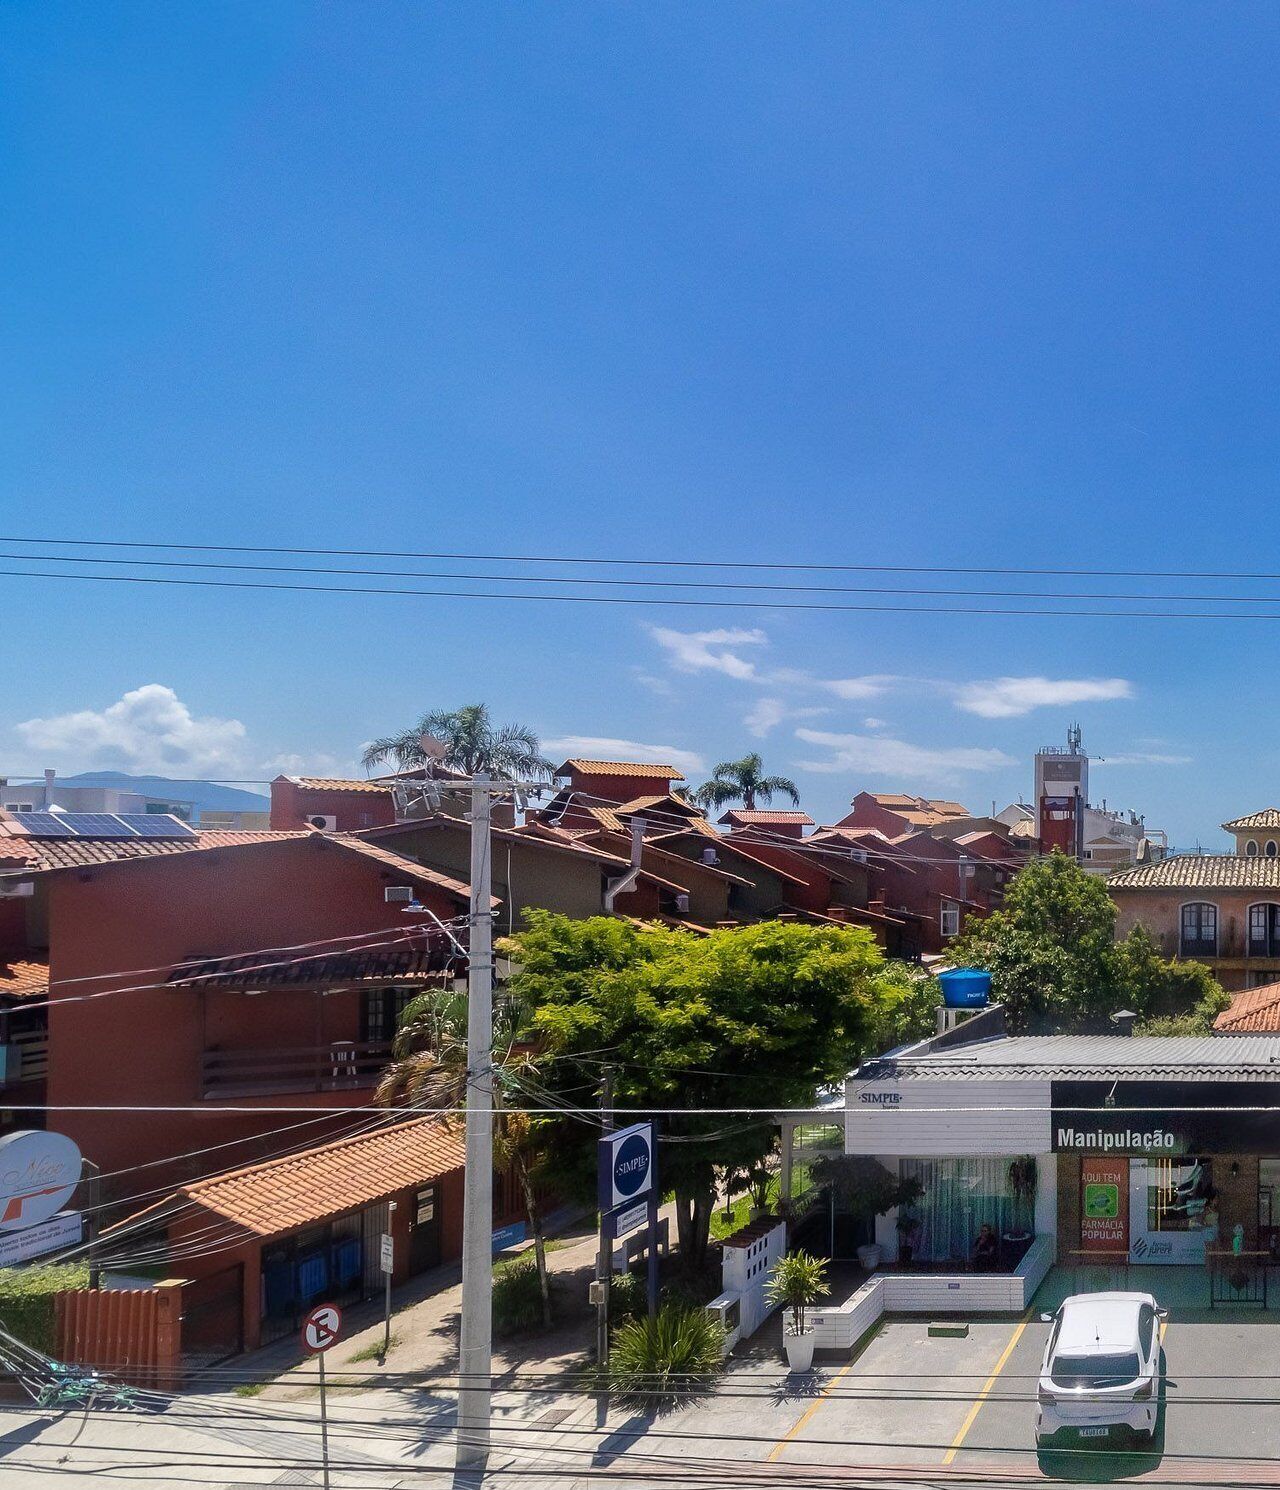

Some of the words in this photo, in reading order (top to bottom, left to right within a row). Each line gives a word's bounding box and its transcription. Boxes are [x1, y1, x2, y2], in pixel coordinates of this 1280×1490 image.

[861, 1092, 900, 1104] SIMPLE
[1057, 1128, 1175, 1152] Manipulação
[617, 1154, 647, 1176] SIMPLE
[1081, 1173, 1101, 1183] AQUI
[1103, 1173, 1121, 1182] TEM
[1081, 1219, 1124, 1230] FARMÁCIA
[1081, 1230, 1124, 1240] POPULAR
[315, 1312, 331, 1343] E
